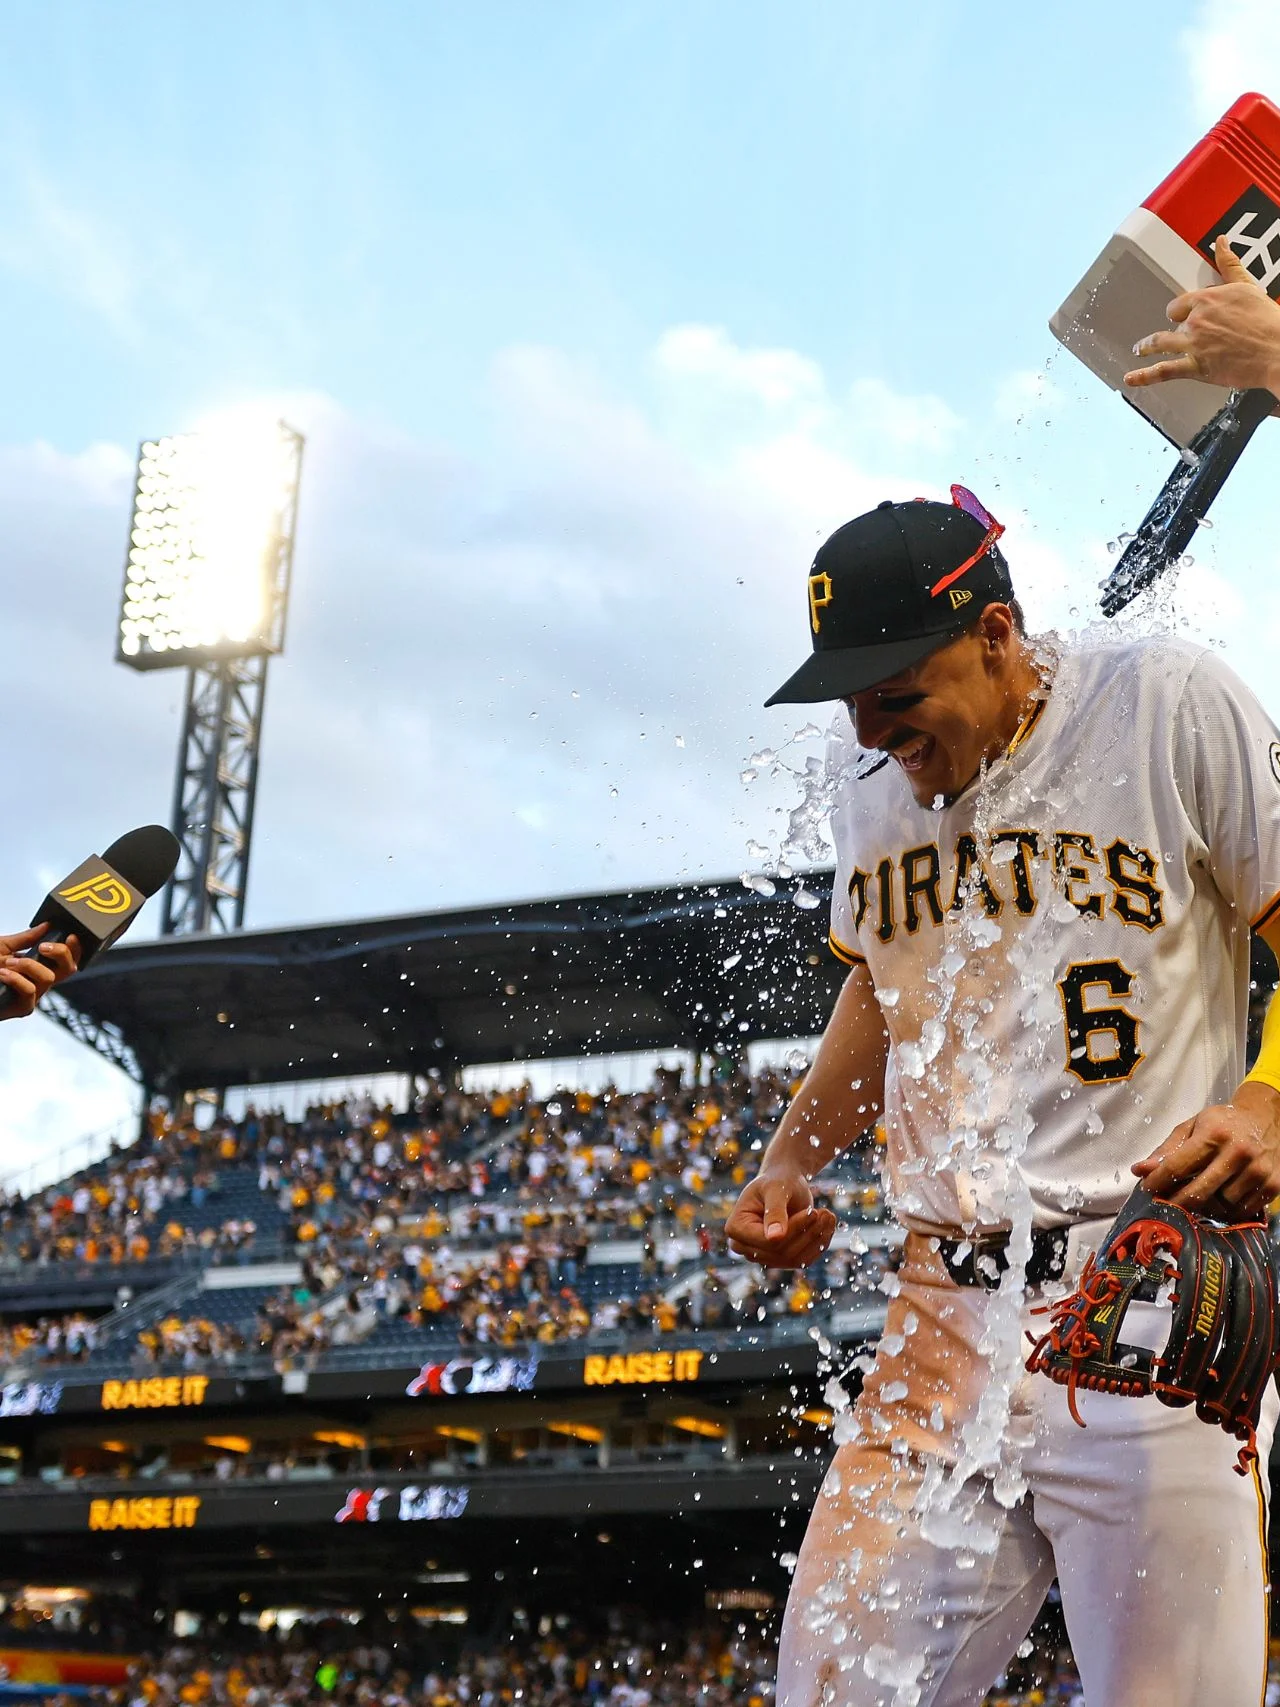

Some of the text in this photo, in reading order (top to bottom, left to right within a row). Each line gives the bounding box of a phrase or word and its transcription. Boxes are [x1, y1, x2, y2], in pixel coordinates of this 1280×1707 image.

[808, 571, 834, 634] P
[1056, 958, 1146, 1086] 6
[584, 1349, 703, 1386] RAISE IT
[101, 1376, 181, 1410] RAISE
[182, 1374, 209, 1406] IT
[88, 1495, 201, 1531] RAISE IT
